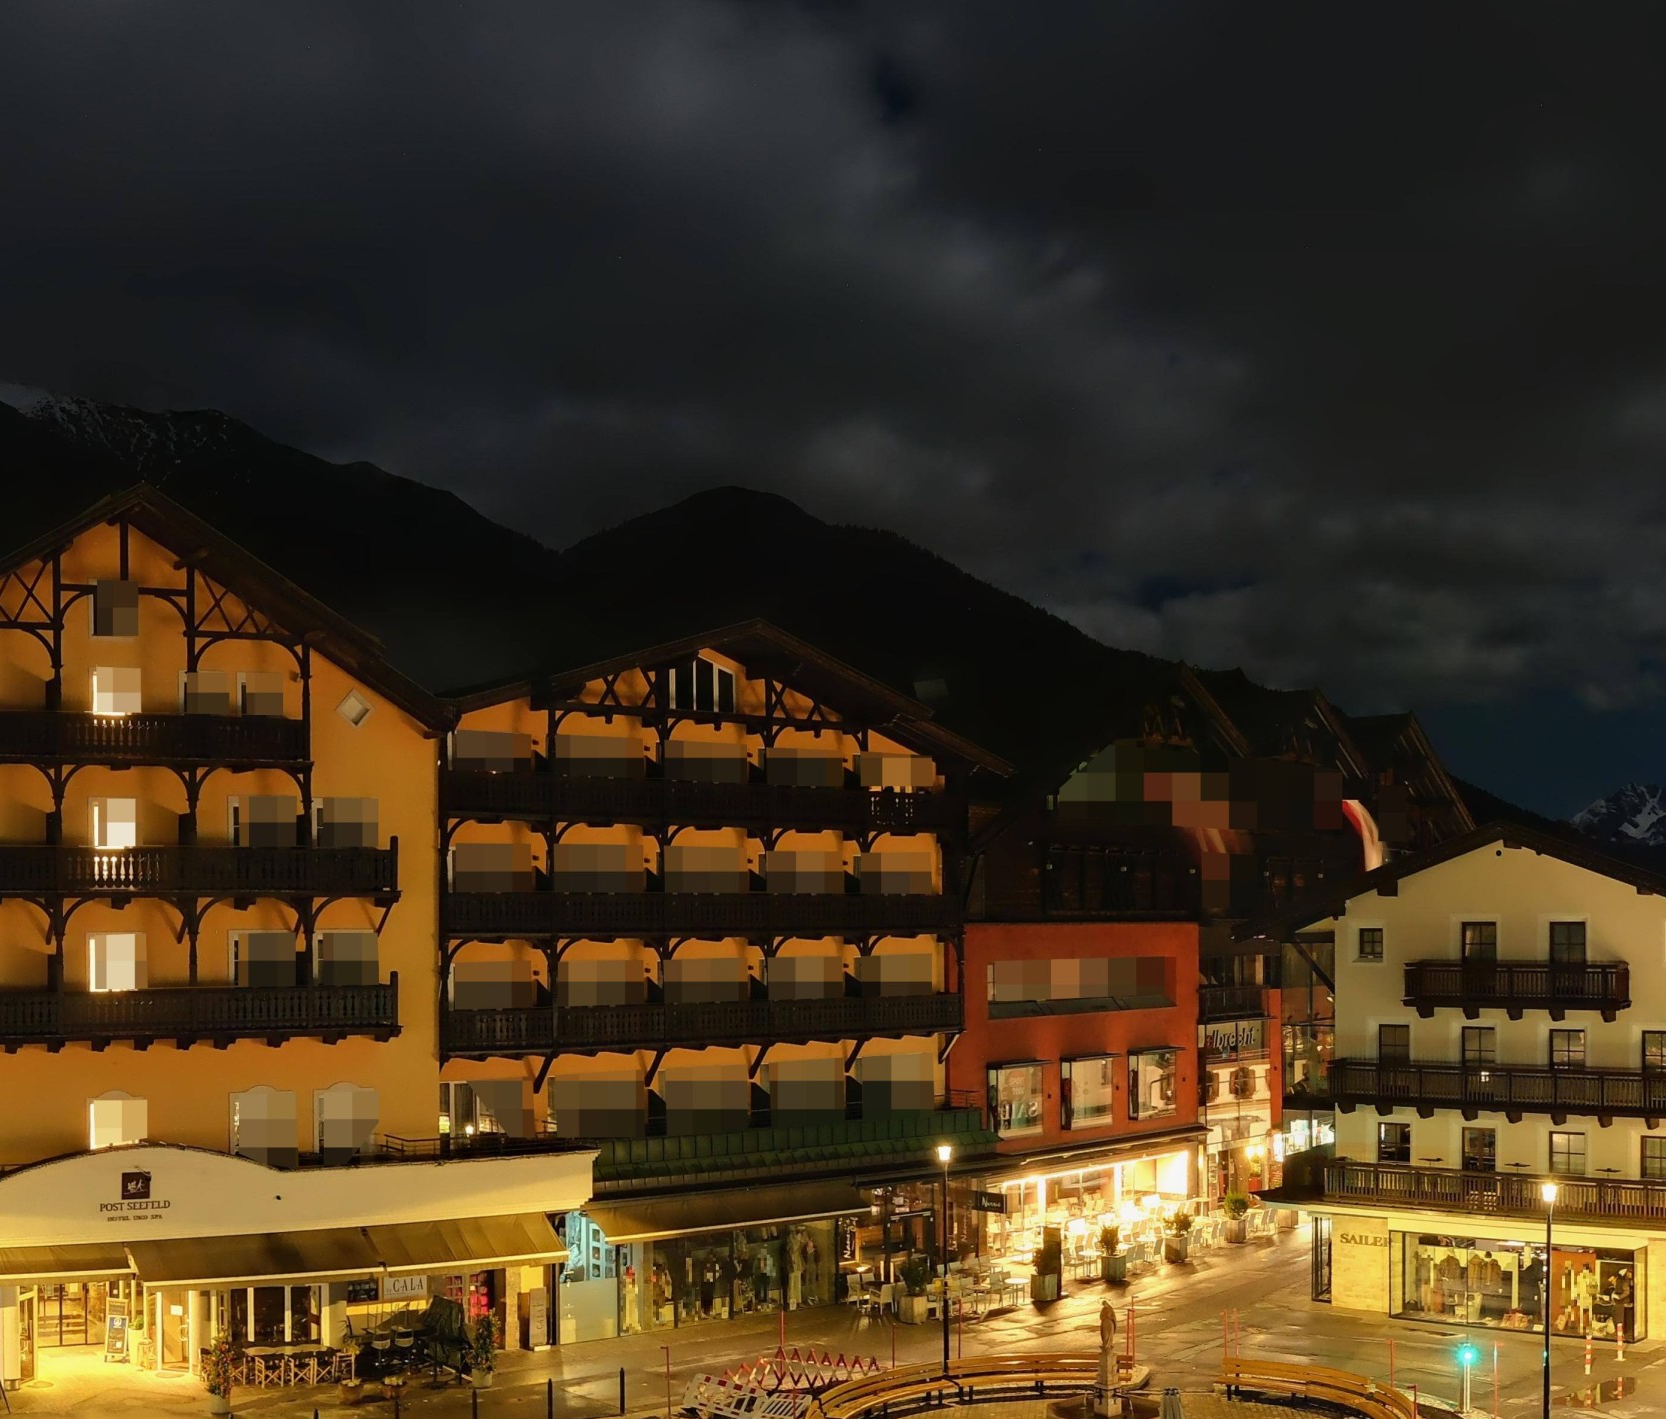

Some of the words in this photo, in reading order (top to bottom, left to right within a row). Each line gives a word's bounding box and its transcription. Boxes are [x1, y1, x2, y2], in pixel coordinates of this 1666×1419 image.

[100, 1202, 125, 1212] POST
[127, 1200, 171, 1211] SEEFELD
[393, 1277, 424, 1293] CALA
